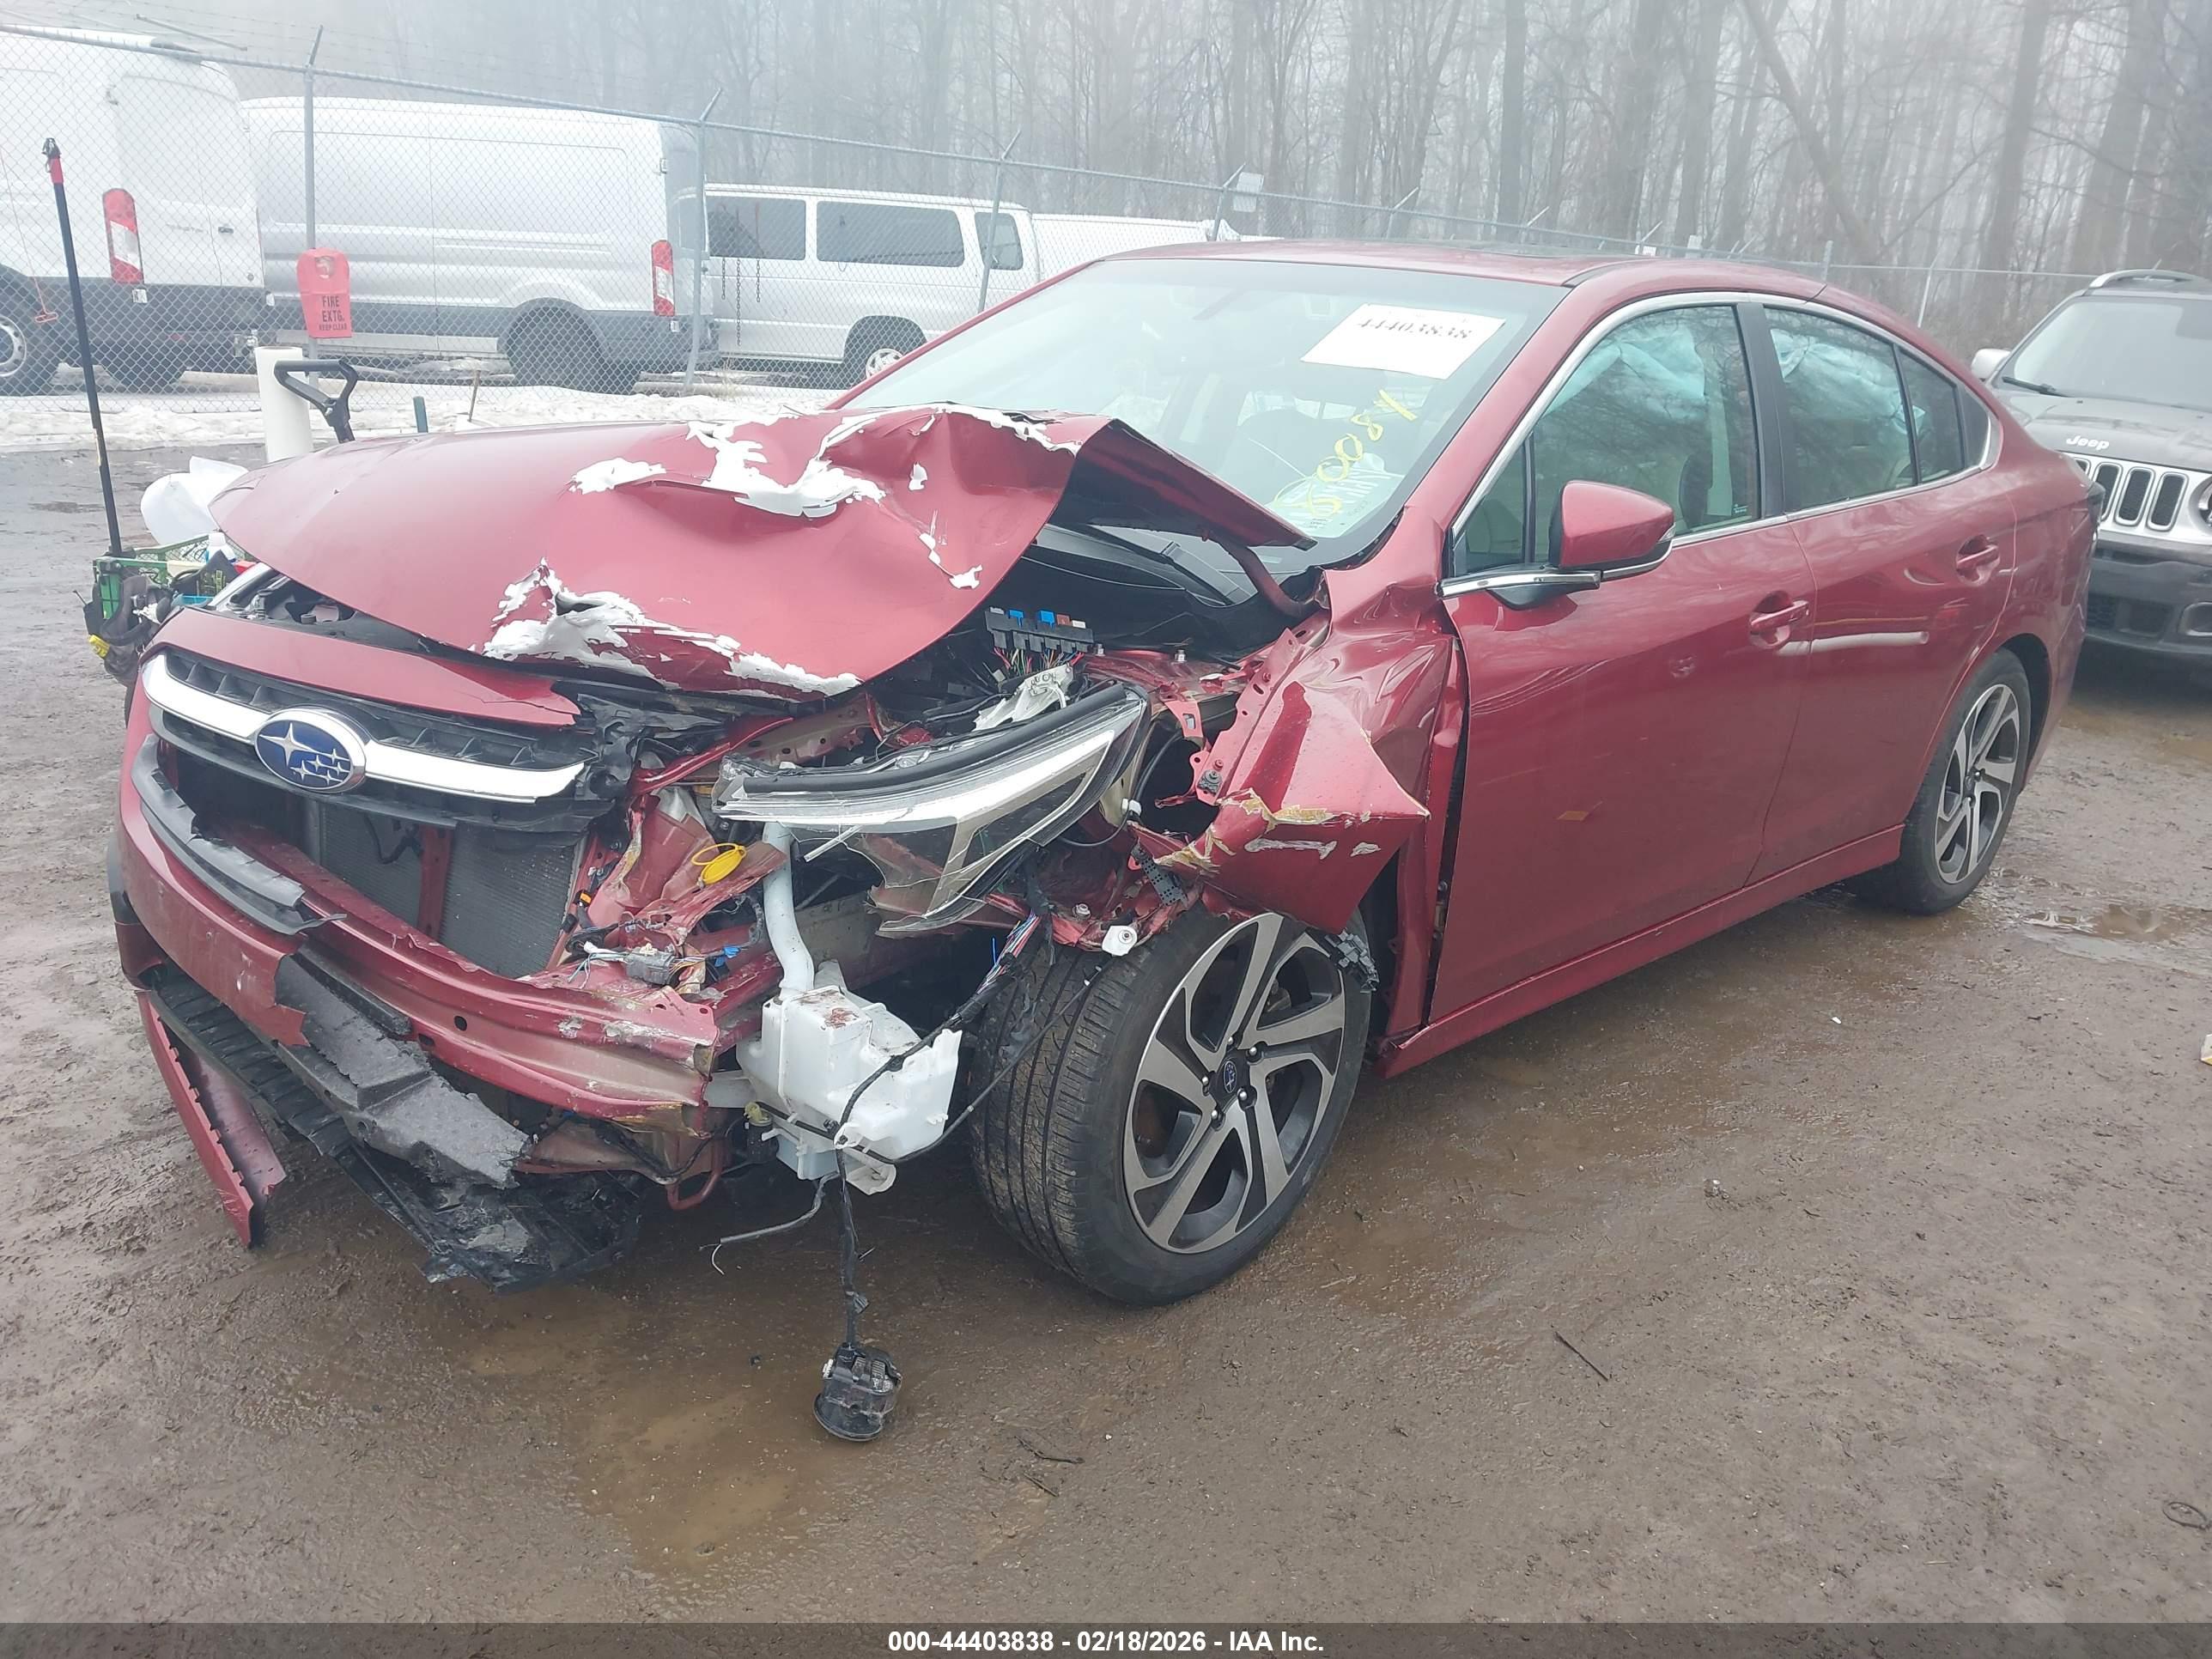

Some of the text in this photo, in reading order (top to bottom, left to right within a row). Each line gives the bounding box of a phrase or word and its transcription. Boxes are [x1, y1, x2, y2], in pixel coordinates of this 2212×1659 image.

[322, 295, 340, 308] FIRE
[322, 310, 345, 322] EXTG.
[1358, 318, 1473, 339] 44403838
[2065, 434, 2110, 451] Jeep
